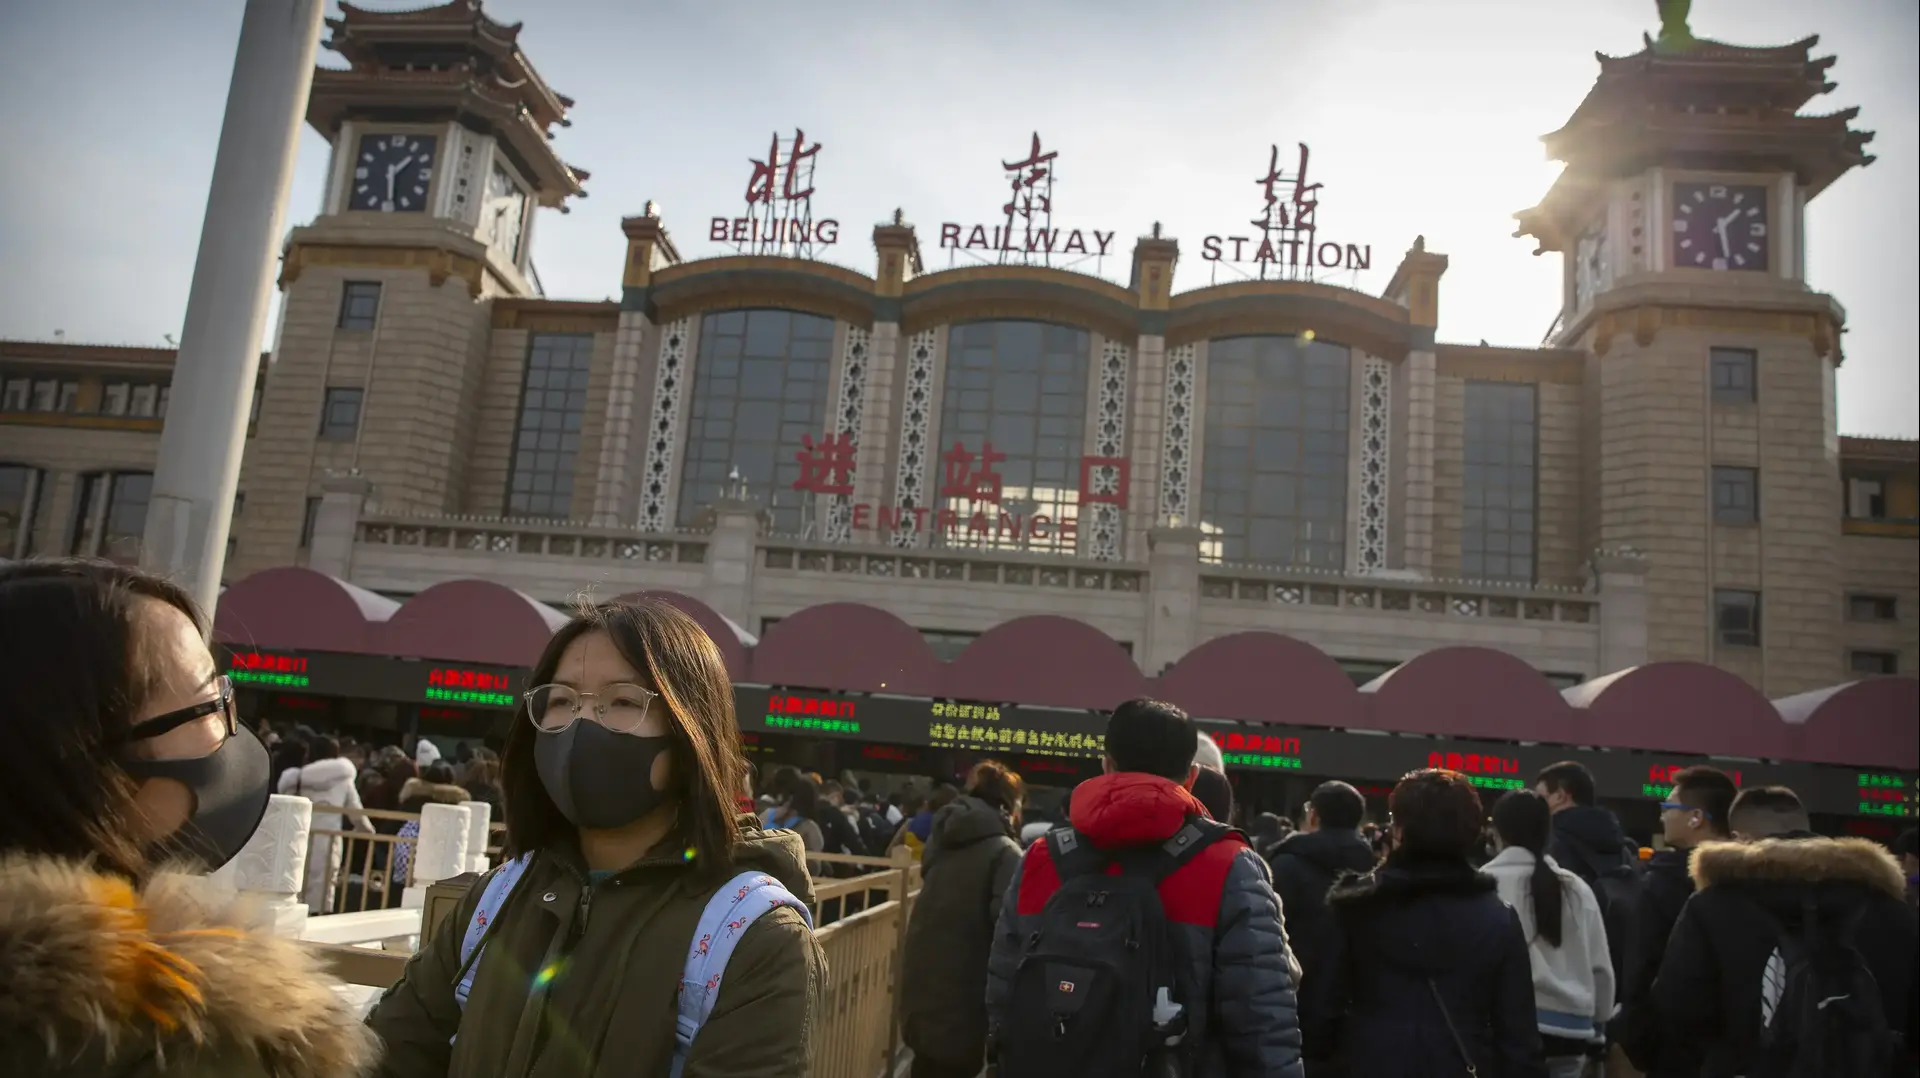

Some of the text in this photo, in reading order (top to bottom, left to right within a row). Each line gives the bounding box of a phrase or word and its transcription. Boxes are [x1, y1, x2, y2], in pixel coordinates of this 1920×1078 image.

[709, 217, 1371, 270] BEIJING RAILWAY STATION
[792, 432, 1131, 510] 进站口
[852, 504, 1079, 541] ENTRANCE
